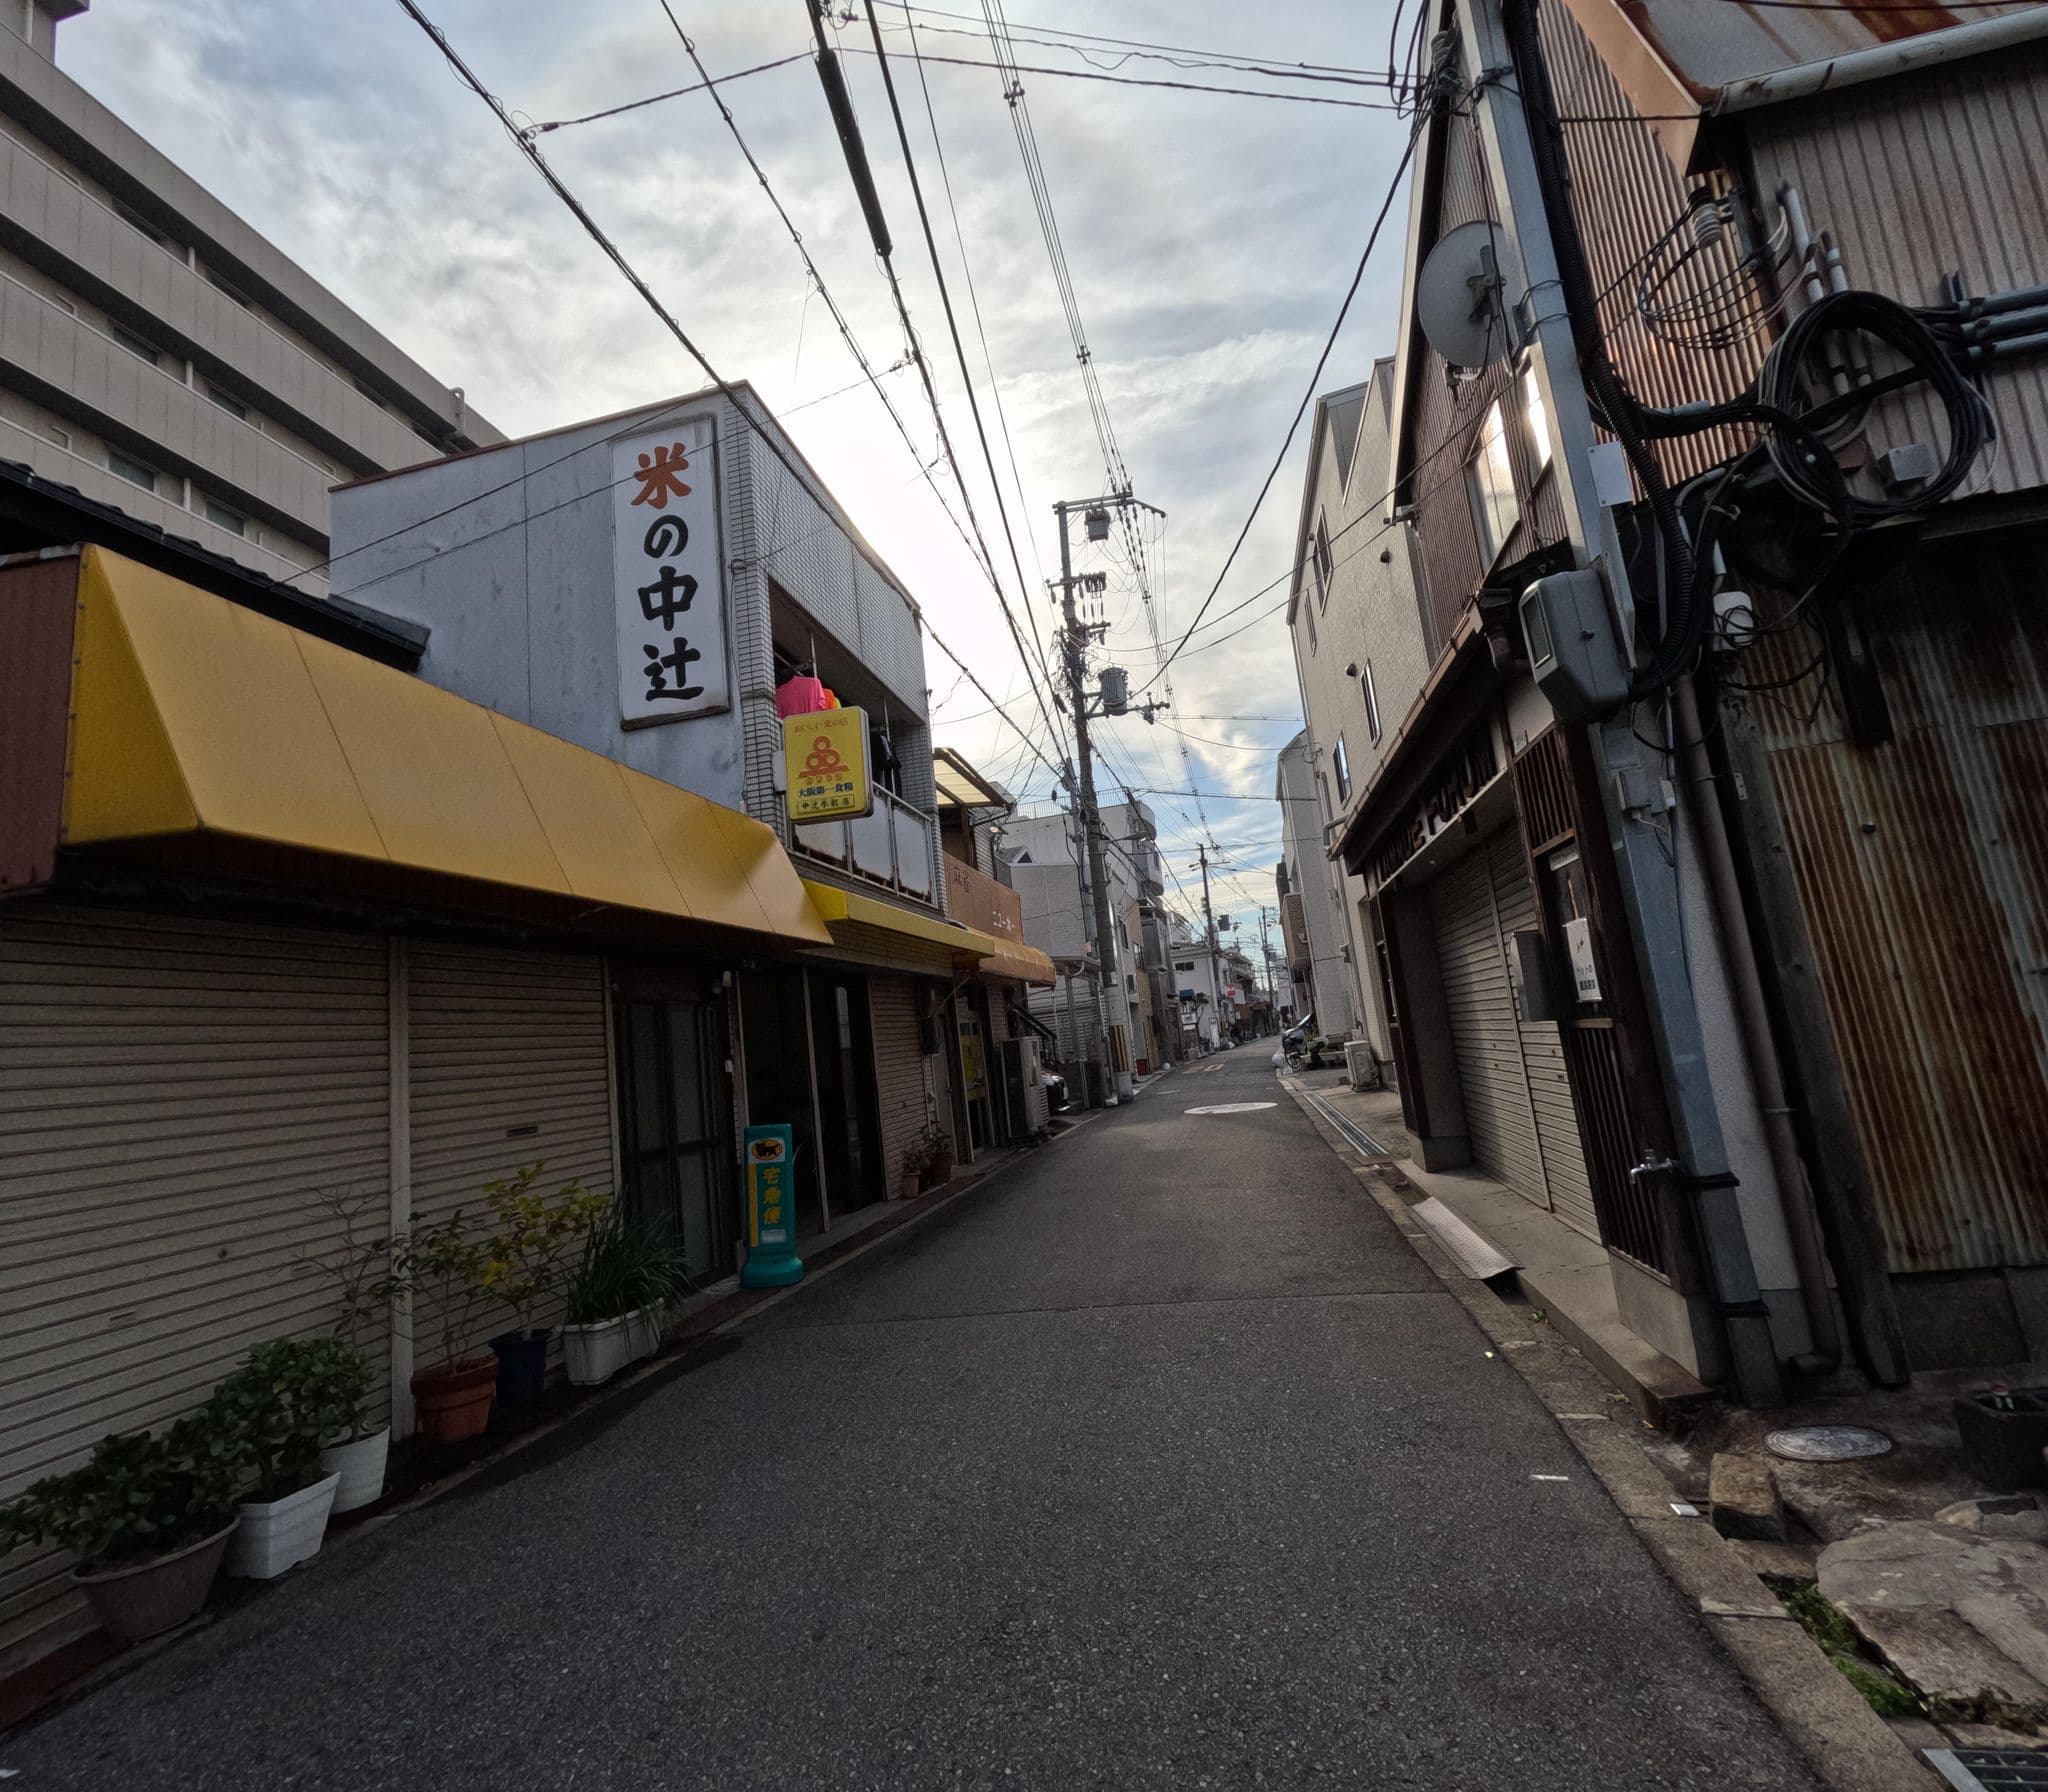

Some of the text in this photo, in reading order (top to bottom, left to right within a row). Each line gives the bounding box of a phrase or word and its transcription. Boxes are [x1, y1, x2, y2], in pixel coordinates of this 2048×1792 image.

[631, 442, 704, 701] 米の中辻
[763, 1167, 781, 1224] 宅急便
